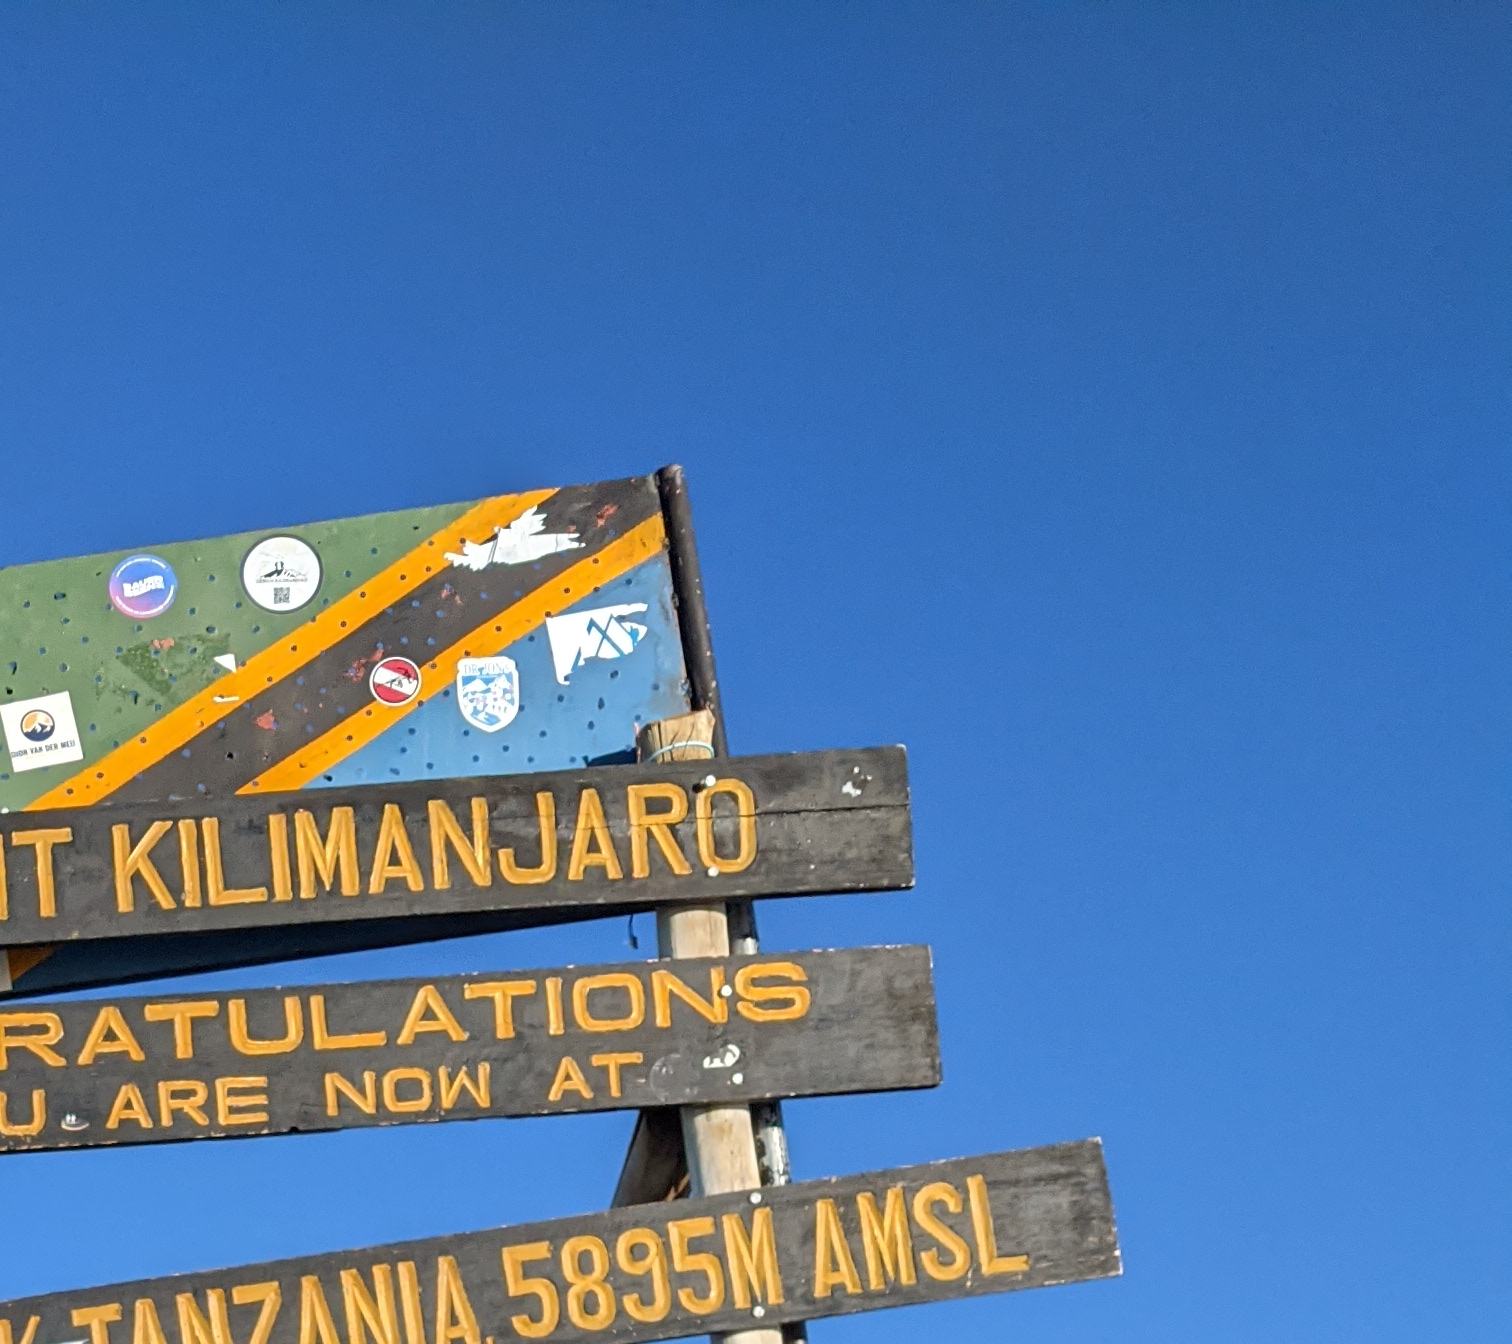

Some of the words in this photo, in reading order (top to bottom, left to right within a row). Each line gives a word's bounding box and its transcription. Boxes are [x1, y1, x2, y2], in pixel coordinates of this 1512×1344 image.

[112, 779, 756, 913] KILIMANJARO
[106, 1076, 268, 1129] ARE
[324, 1064, 490, 1116] NOW
[548, 1052, 642, 1101] AT
[502, 1208, 783, 1338] 5895M
[814, 1176, 1030, 1298] AMSL
